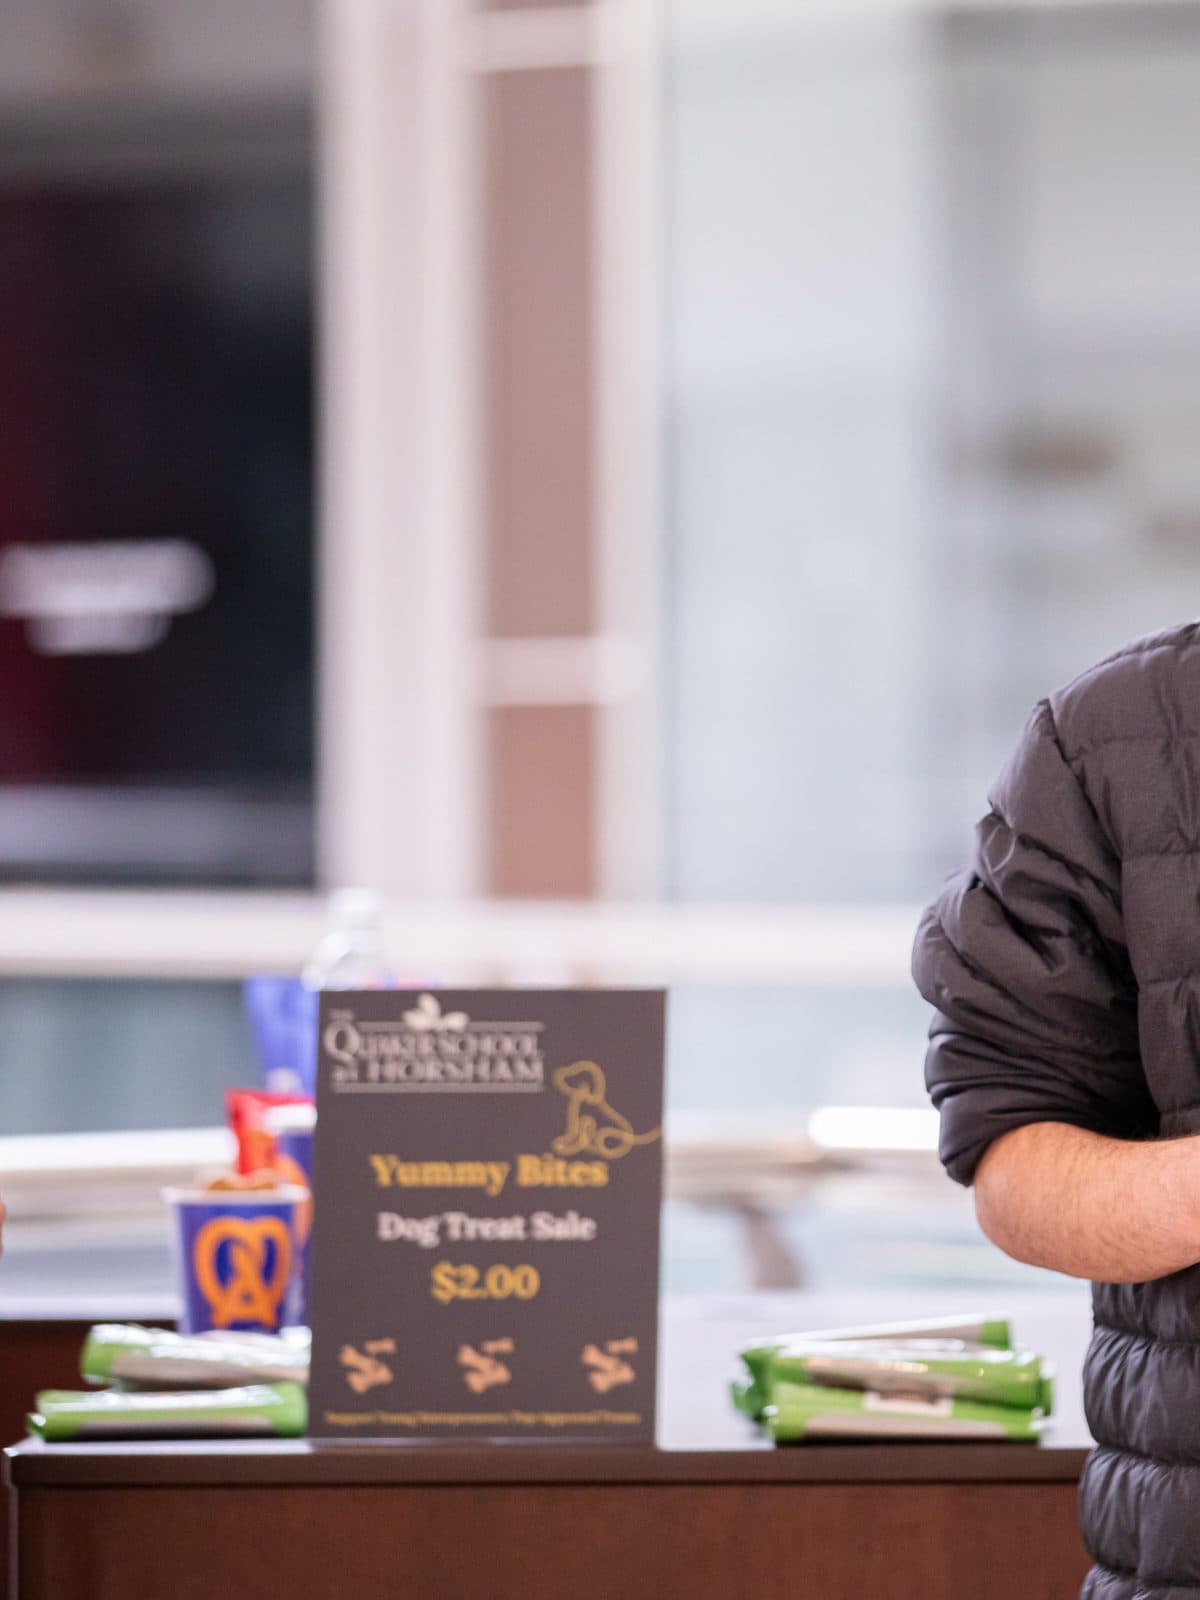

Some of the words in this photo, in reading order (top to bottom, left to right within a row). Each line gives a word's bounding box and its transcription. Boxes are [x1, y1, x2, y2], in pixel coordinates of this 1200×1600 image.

[366, 1056, 544, 1083] HORSHAM
[369, 1154, 509, 1196] Yummy
[516, 1153, 610, 1188] Bites
[377, 1211, 440, 1248] Dog
[443, 1211, 526, 1241] Treat
[530, 1209, 597, 1241] Sale
[431, 1260, 541, 1304] $2.00
